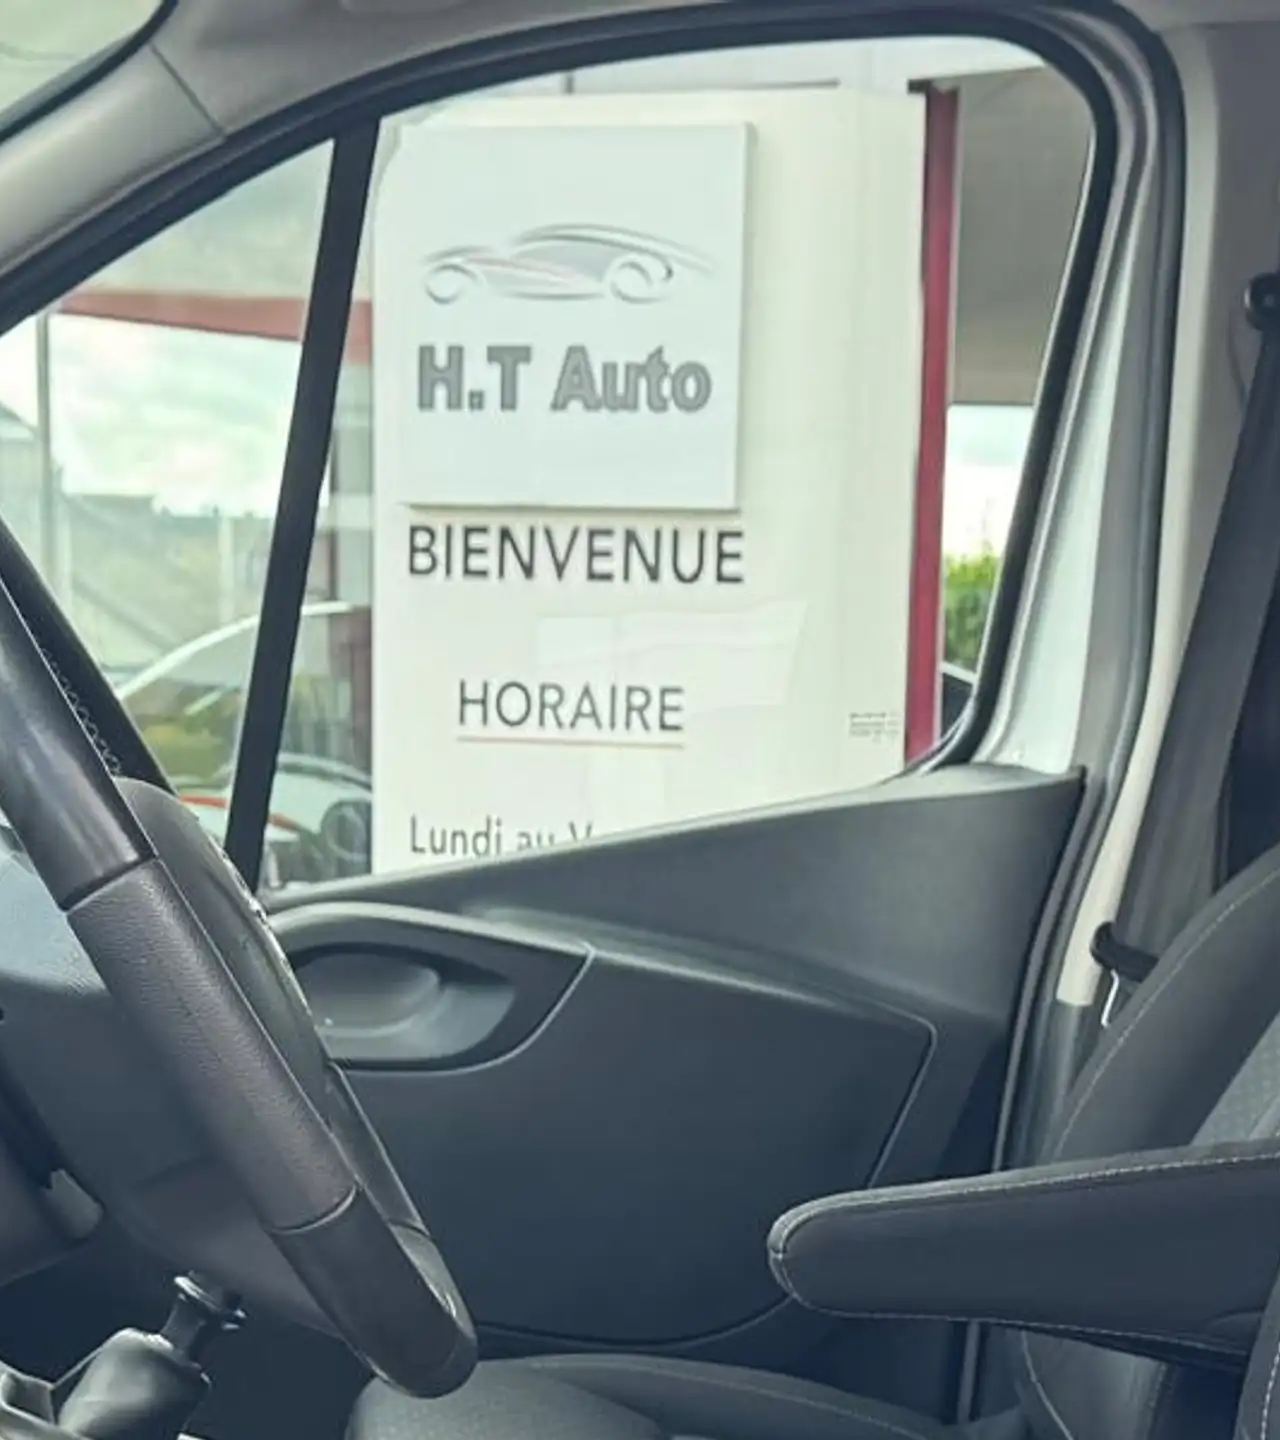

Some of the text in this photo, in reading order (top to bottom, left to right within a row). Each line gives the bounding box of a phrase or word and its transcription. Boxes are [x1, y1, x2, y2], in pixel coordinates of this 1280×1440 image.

[417, 345, 712, 414] H.T Auto
[408, 525, 744, 584] BIENVENUE
[458, 678, 684, 731] HORAIRE
[410, 814, 502, 856] Lundi
